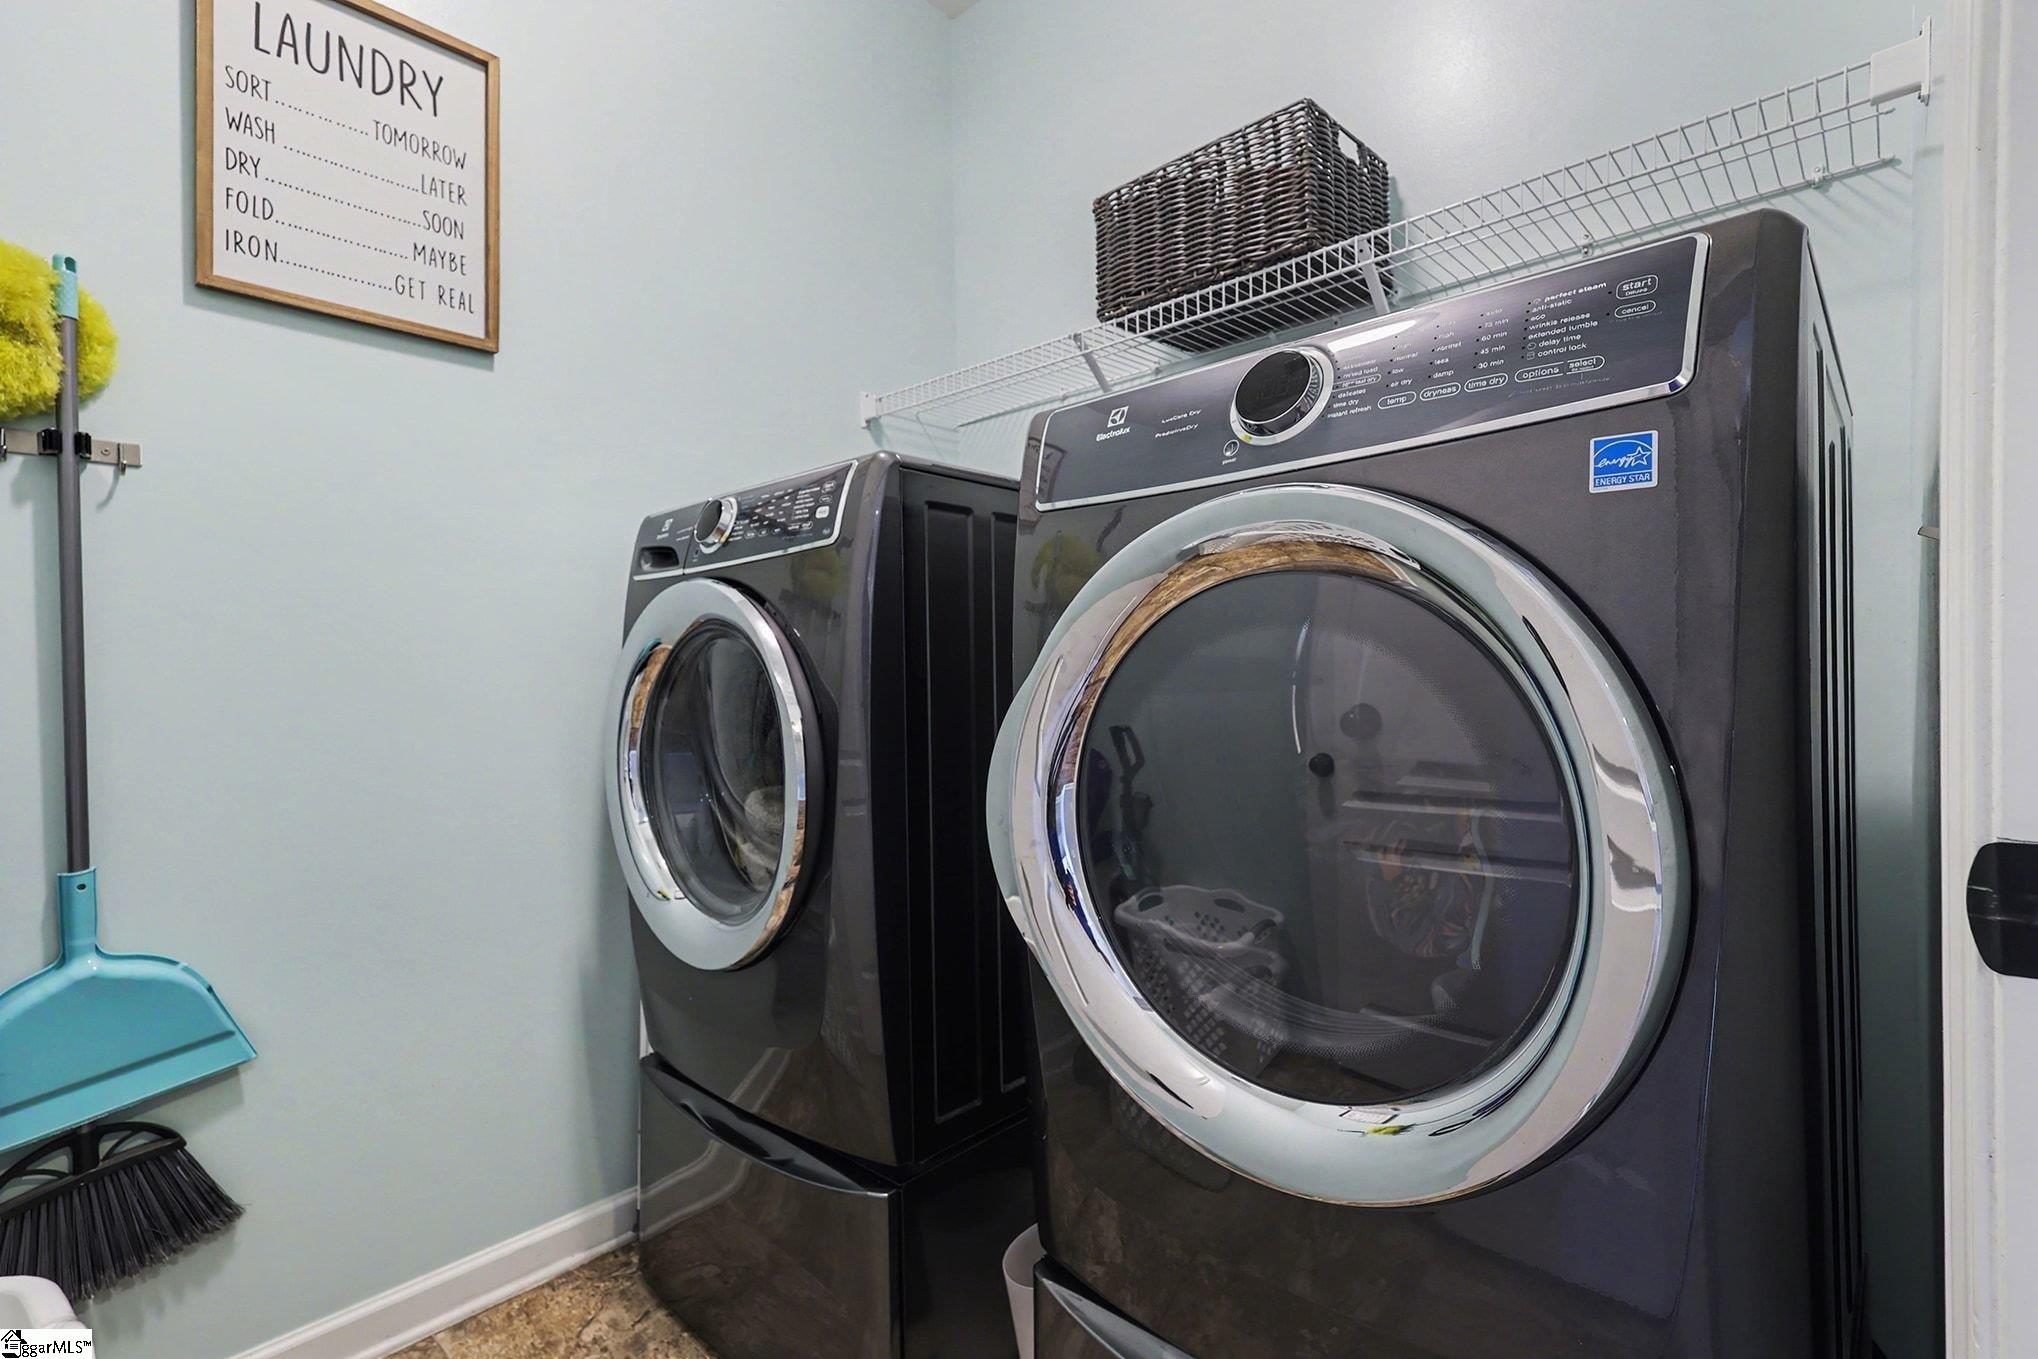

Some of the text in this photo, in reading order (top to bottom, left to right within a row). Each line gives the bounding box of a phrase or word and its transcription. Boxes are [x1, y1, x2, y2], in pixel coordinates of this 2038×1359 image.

[254, 2, 444, 117] LAUNDRY
[372, 119, 467, 170] TOMORROW
[225, 107, 467, 206] WASH LATER
[225, 147, 464, 240] DRY SOON
[225, 187, 467, 276] FOLD MAYBE
[225, 229, 474, 314] IRON GET REAL
[1622, 278, 1652, 291] start
[1544, 282, 1607, 302] perfect steam
[1532, 299, 1572, 313] anti-static
[1621, 303, 1649, 315] cancel
[1529, 312, 1591, 330] wrinkle release
[1481, 331, 1508, 342] 60 min
[1528, 320, 1598, 340] extended tumble
[1538, 334, 1581, 347] delay time
[1491, 345, 1506, 353] min
[1538, 342, 1588, 357] control lock
[1434, 357, 1449, 365] less
[1477, 359, 1504, 369] 30 min
[1363, 366, 1379, 375] load
[1433, 370, 1454, 379] damp
[1522, 367, 1560, 379] options
[1569, 358, 1596, 369] select
[1400, 378, 1413, 386] dry
[1468, 380, 1487, 390] time
[1489, 376, 1505, 387] dry
[1423, 386, 1457, 398] dryness
[1347, 399, 1360, 407] dry
[1387, 396, 1407, 405] temp
[1349, 405, 1372, 415] refresh
[1096, 426, 1131, 442] Electrolux
[1595, 456, 1634, 469] energy
[1595, 472, 1650, 487] ENERGY STAR
